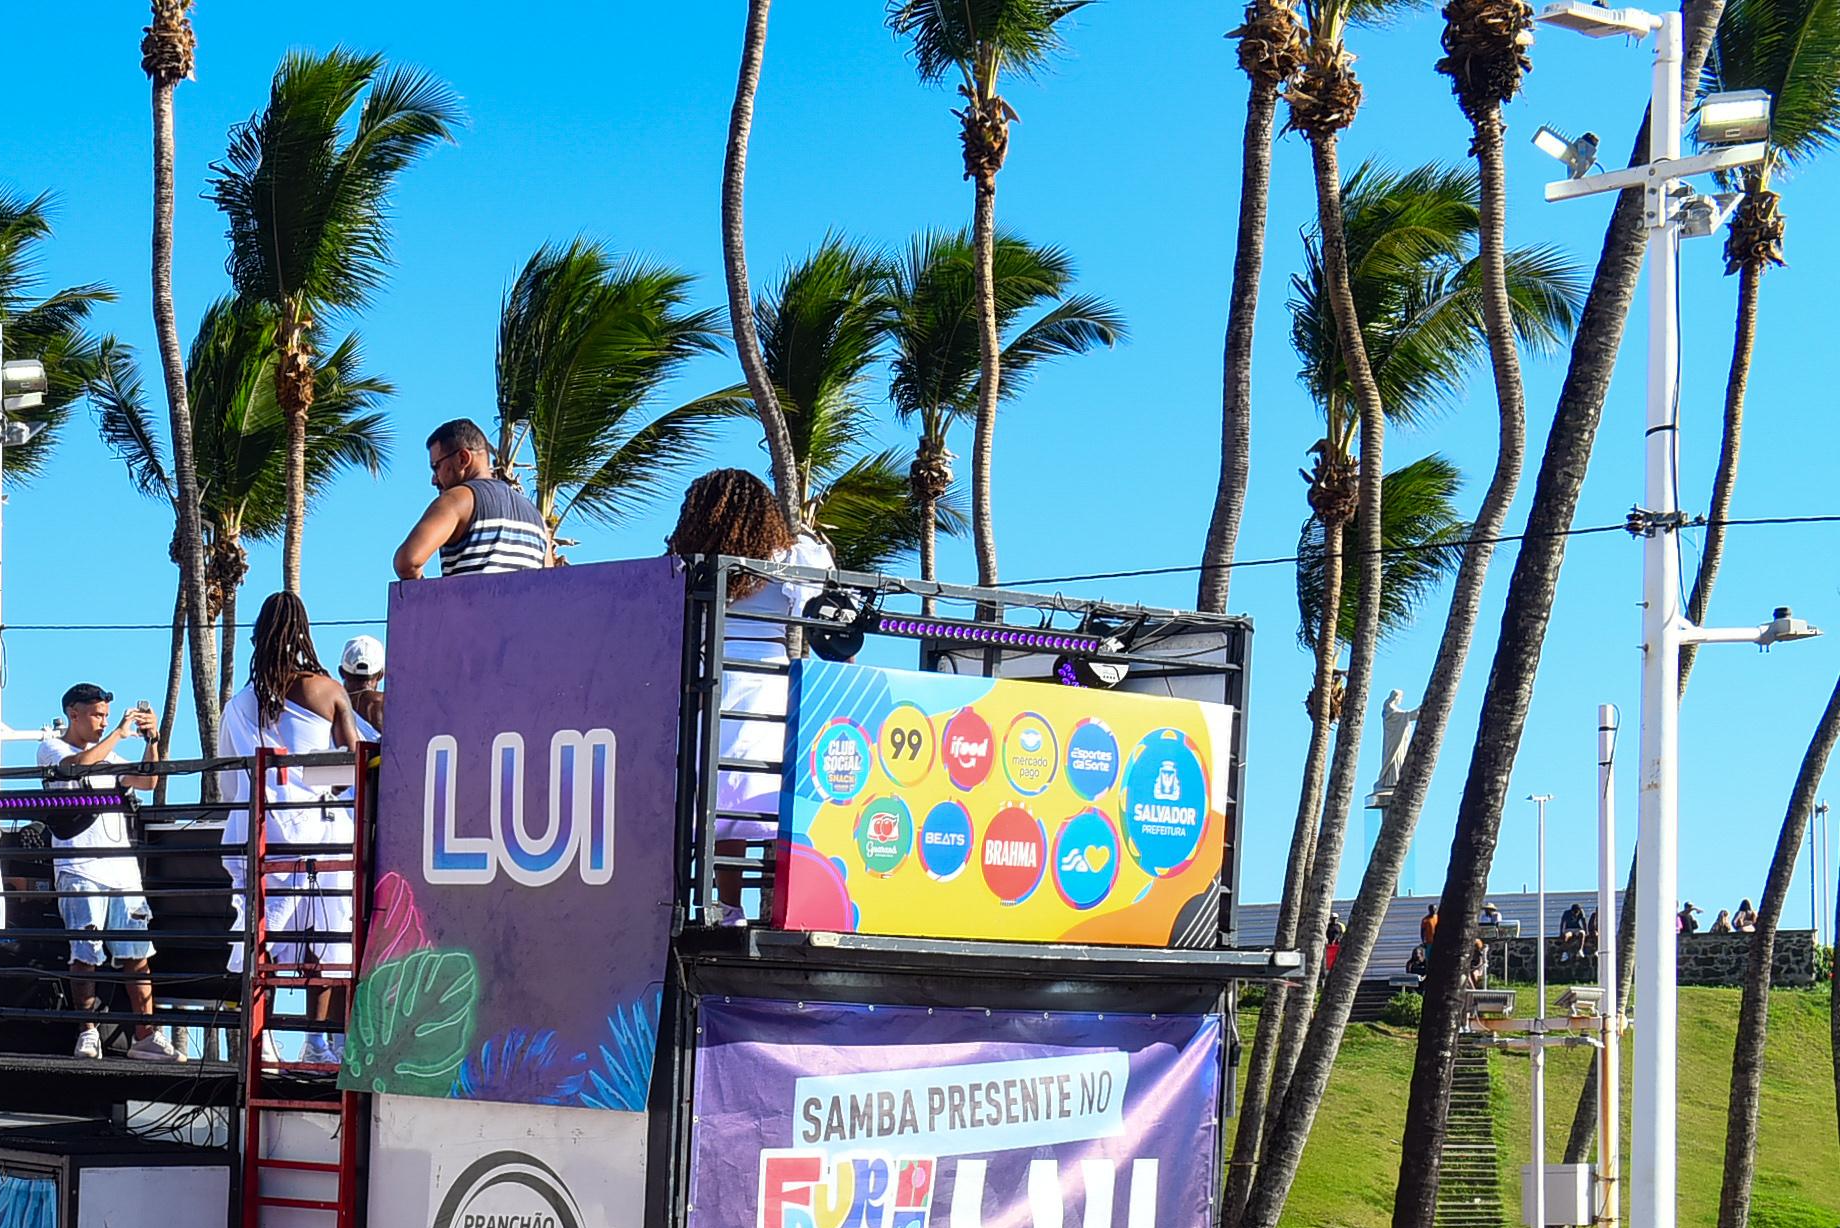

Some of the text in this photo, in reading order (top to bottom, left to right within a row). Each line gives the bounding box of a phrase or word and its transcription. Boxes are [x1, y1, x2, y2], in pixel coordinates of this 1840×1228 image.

[828, 740, 856, 755] CLUB
[890, 727, 923, 761] 99
[1012, 756, 1048, 767] mercado
[1071, 747, 1113, 761] Esportes
[1019, 767, 1040, 780] pago
[423, 728, 616, 887] LUI
[1133, 804, 1196, 825] SALVADOR
[1141, 824, 1186, 837] PREFEITURA
[925, 832, 965, 846] BEATS
[985, 839, 1037, 868] BRAHMA
[802, 1070, 1114, 1144] SAMBA PRESENTE NO
